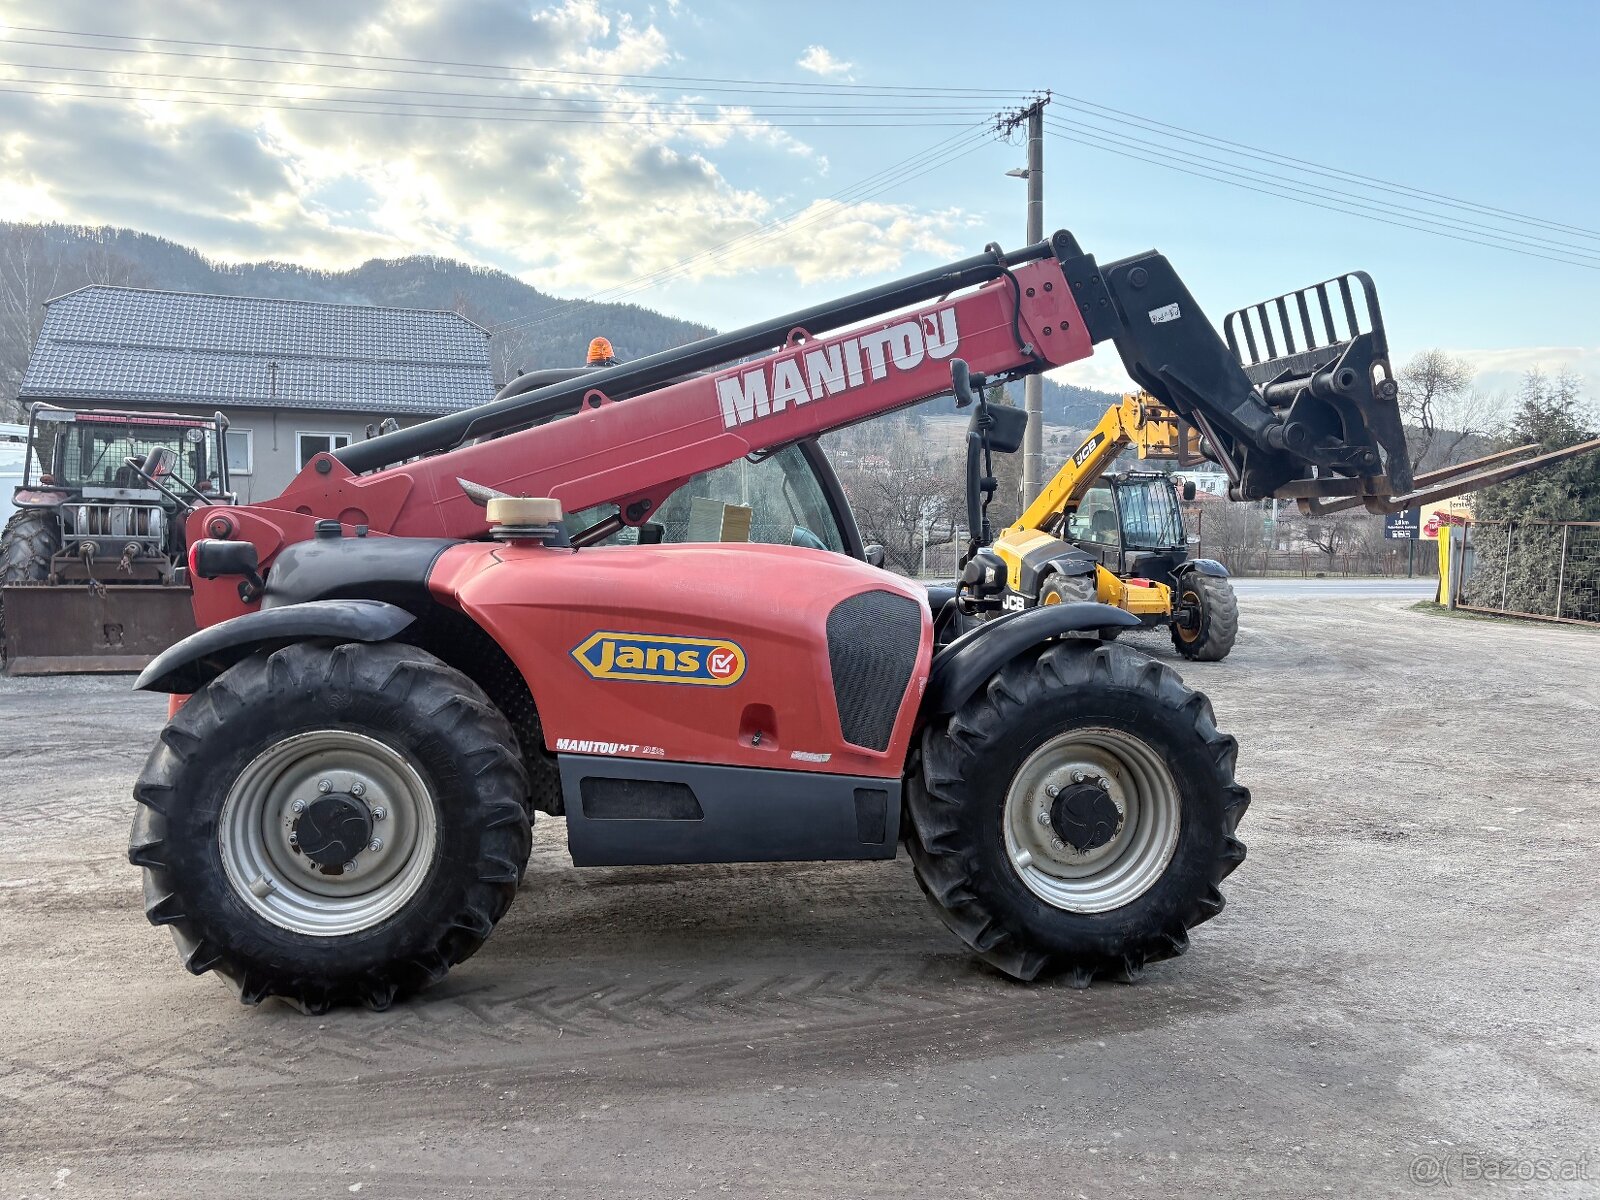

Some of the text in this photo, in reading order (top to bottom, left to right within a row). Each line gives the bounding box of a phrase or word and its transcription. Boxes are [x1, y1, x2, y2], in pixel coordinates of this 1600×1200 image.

[715, 307, 959, 428] MANITOU
[1076, 438, 1097, 467] JCB
[1002, 595, 1025, 611] JCB
[597, 640, 700, 673] Jans
[556, 738, 620, 755] MANITOU
[618, 744, 640, 753] MT
